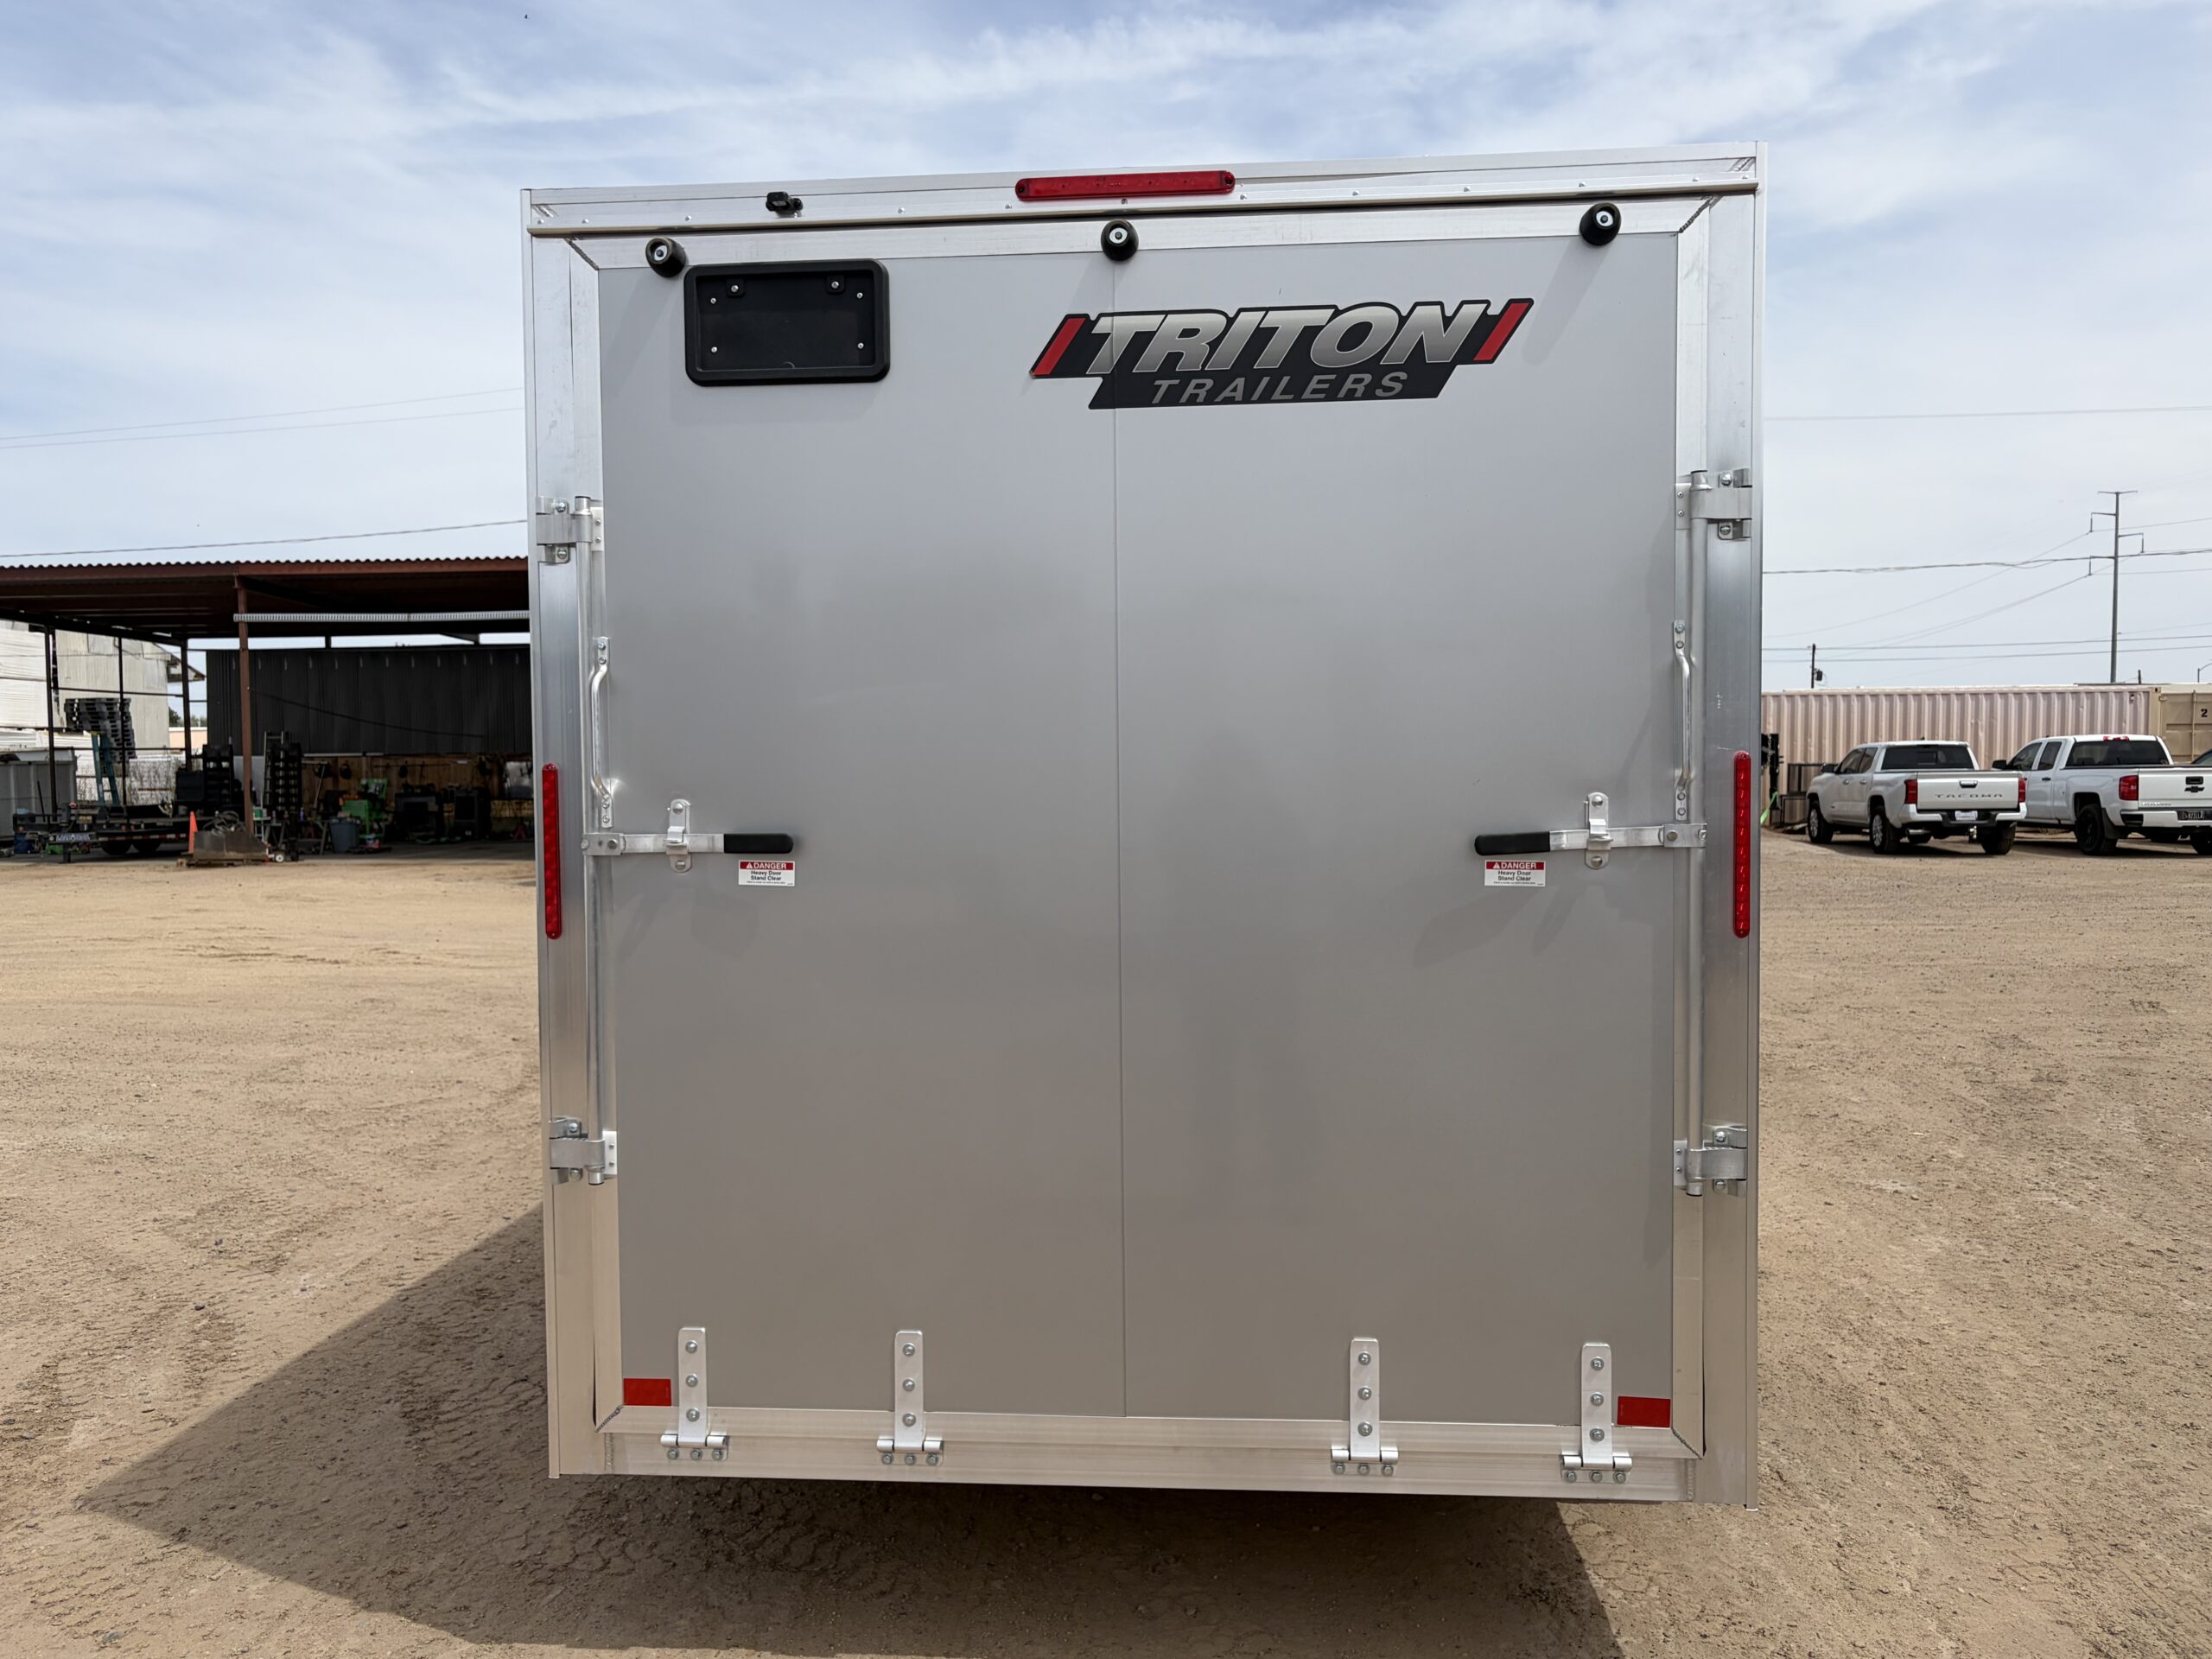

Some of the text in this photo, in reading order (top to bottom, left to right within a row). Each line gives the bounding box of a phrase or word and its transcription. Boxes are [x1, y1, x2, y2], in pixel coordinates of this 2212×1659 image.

[1085, 303, 1489, 374] TRITON
[1151, 372, 1408, 404] TRAILERS
[2201, 709, 2208, 717] 2
